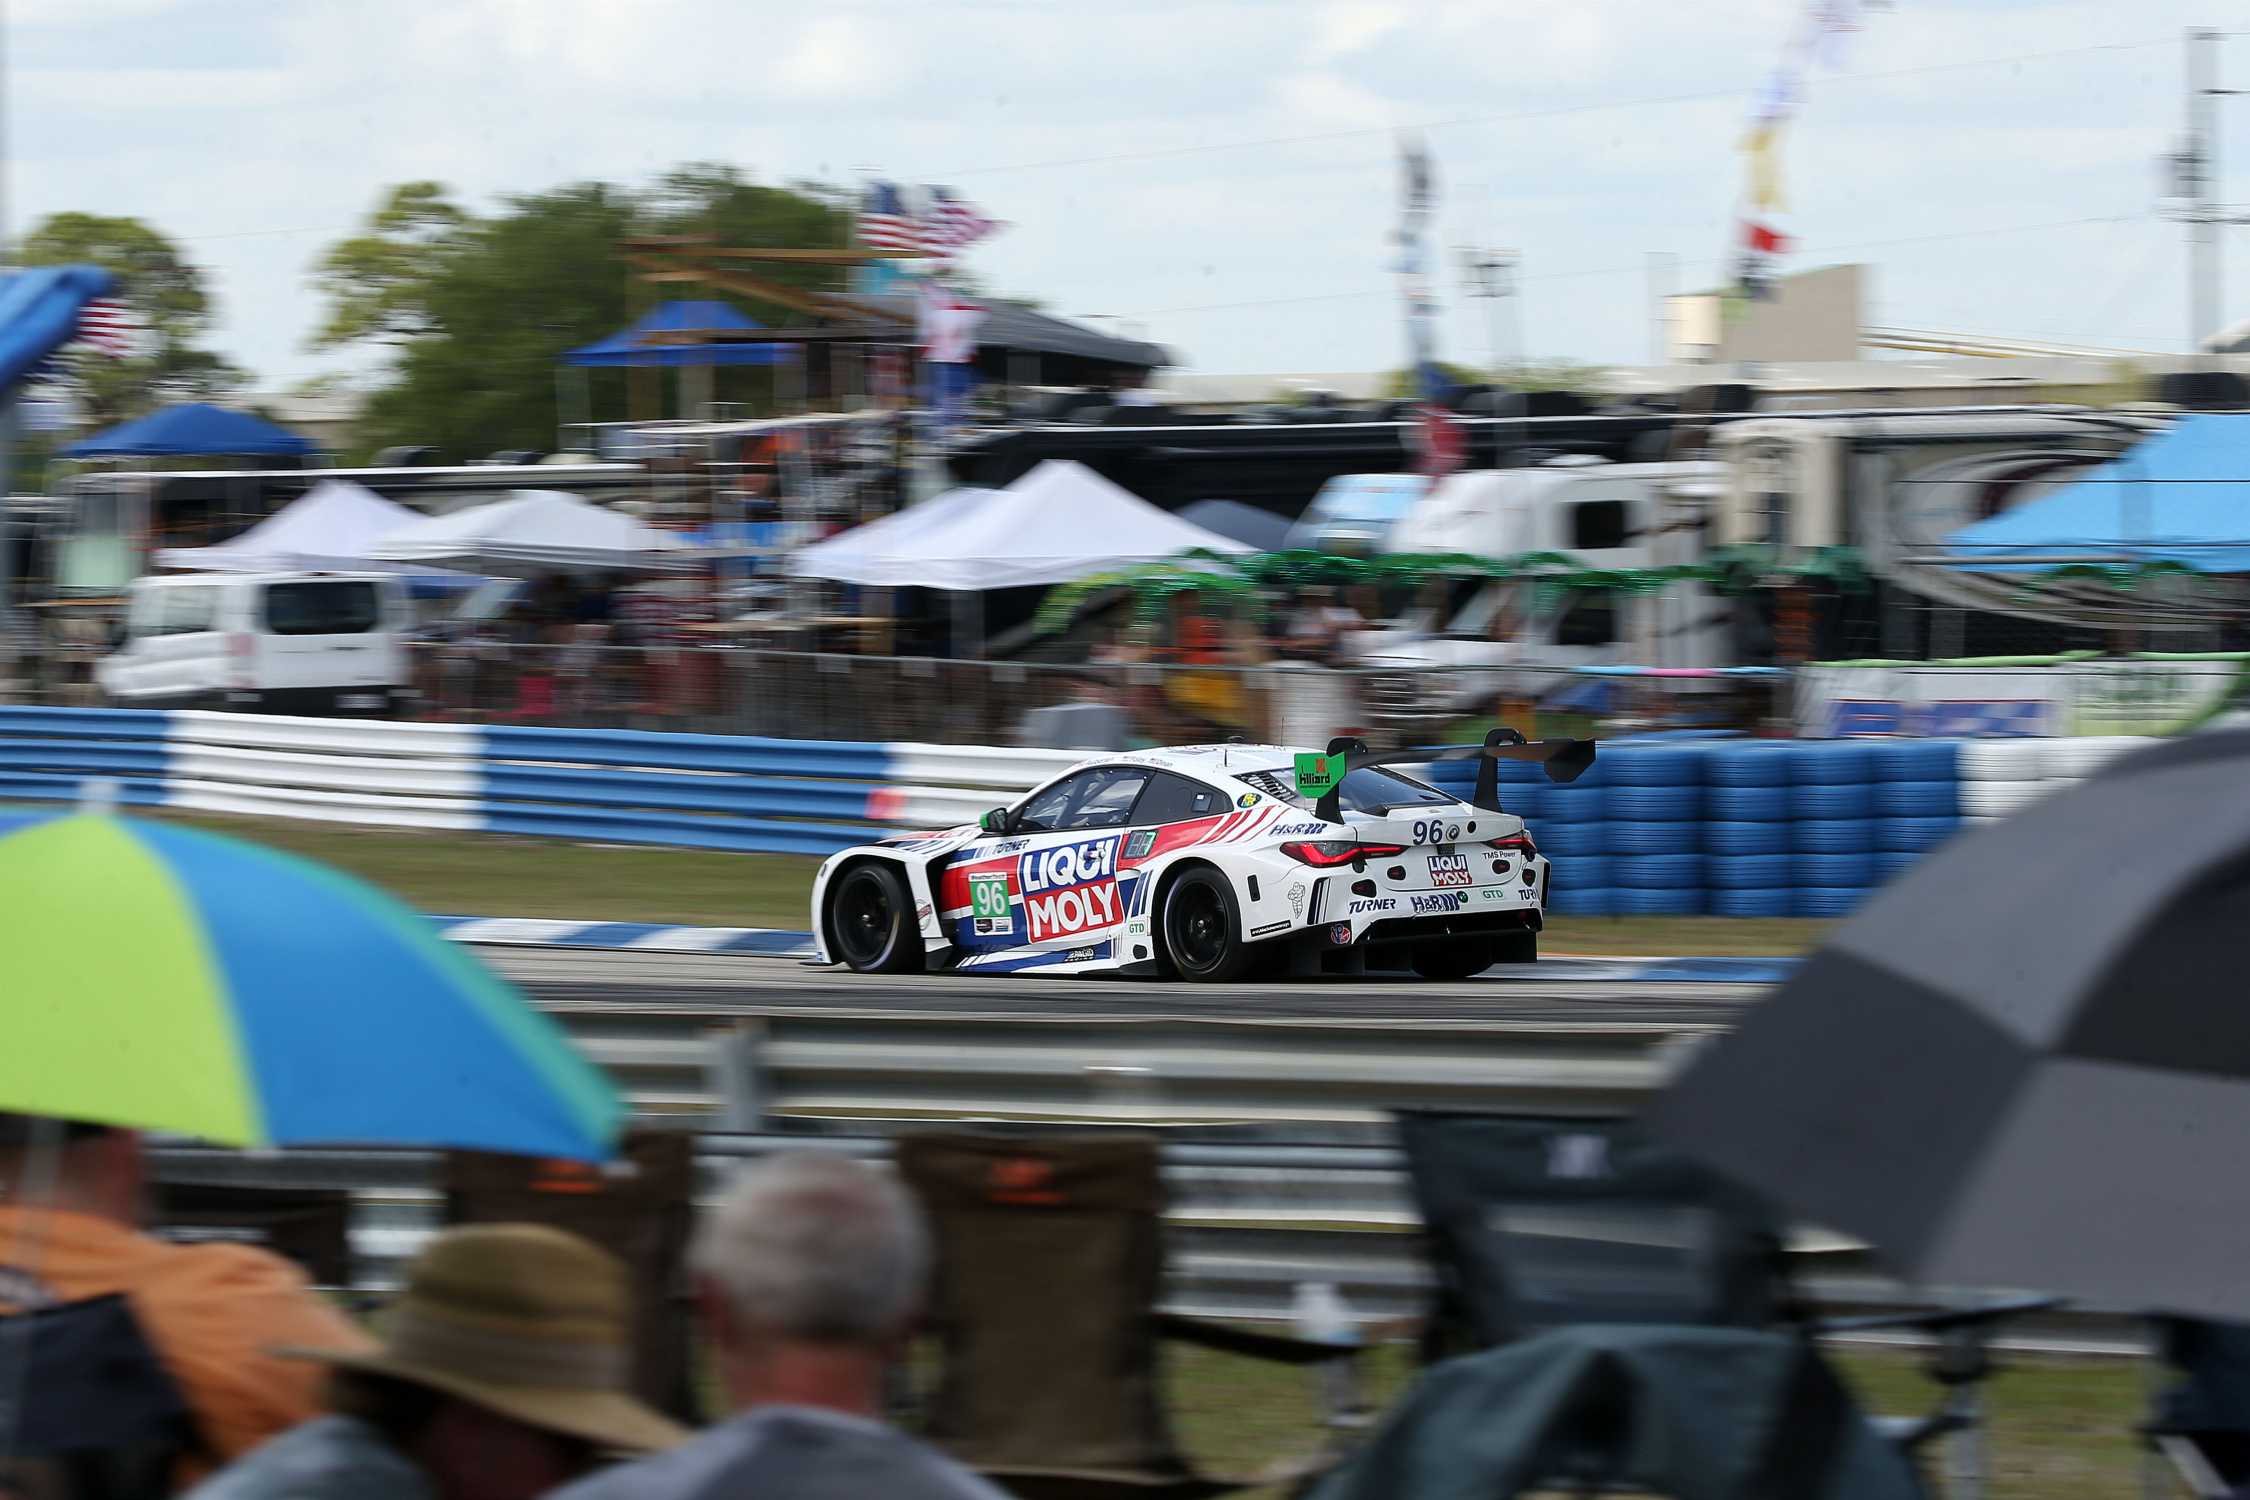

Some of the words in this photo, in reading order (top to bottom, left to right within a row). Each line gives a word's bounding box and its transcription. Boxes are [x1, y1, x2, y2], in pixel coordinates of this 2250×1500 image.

[1412, 820, 1443, 845] 96
[1429, 855, 1467, 871] LIQUI
[1482, 851, 1499, 860] TMS
[1499, 850, 1516, 859] Power
[1023, 838, 1116, 892] LIQUI
[1431, 870, 1470, 886] MOLY
[976, 882, 1006, 915] 96
[1482, 890, 1504, 899] GTD
[1029, 882, 1116, 938] MOLY
[1350, 899, 1396, 914] TURNER
[1410, 895, 1445, 913] H&R
[1129, 923, 1145, 933] GTD
